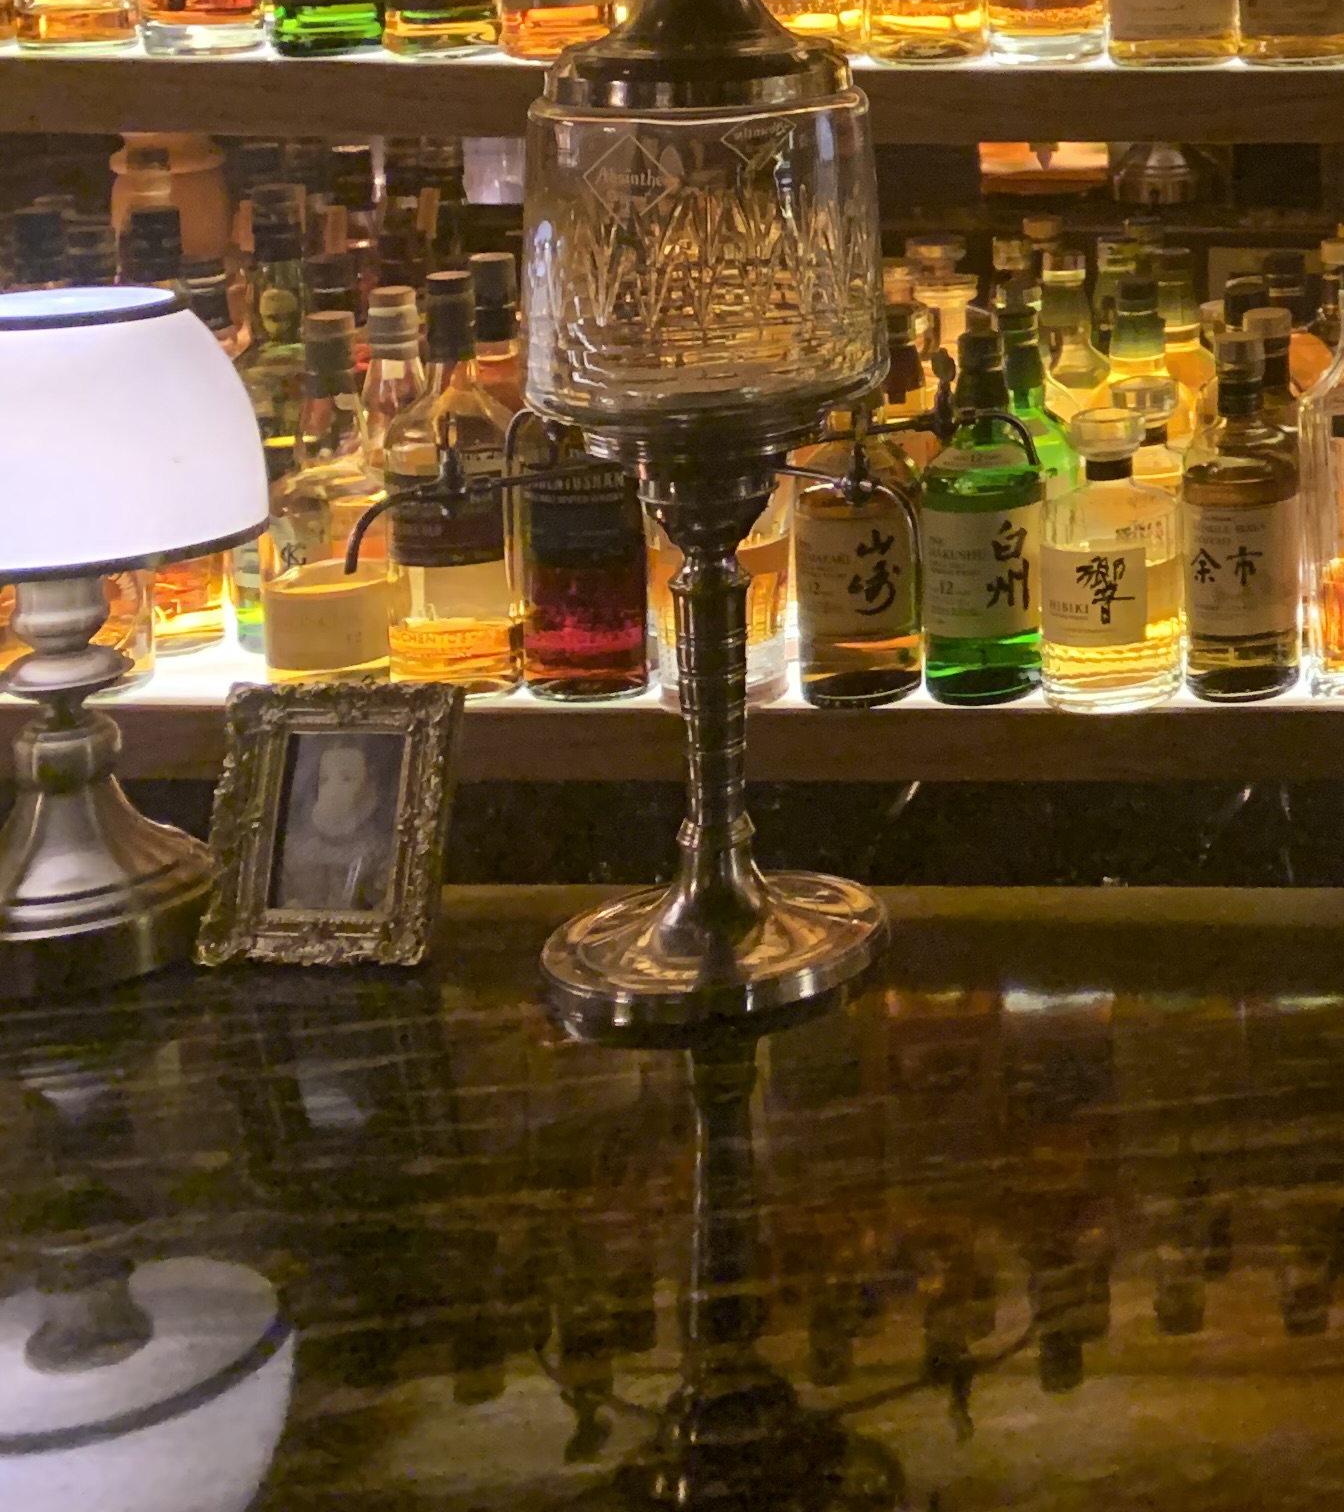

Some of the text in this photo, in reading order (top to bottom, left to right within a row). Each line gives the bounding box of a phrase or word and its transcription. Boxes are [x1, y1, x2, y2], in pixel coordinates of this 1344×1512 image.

[986, 520, 1030, 610] 白州
[1190, 545, 1263, 586] 余市
[939, 580, 954, 595] 12
[1049, 600, 1089, 614] HIBIKI
[1076, 556, 1135, 624] 響
